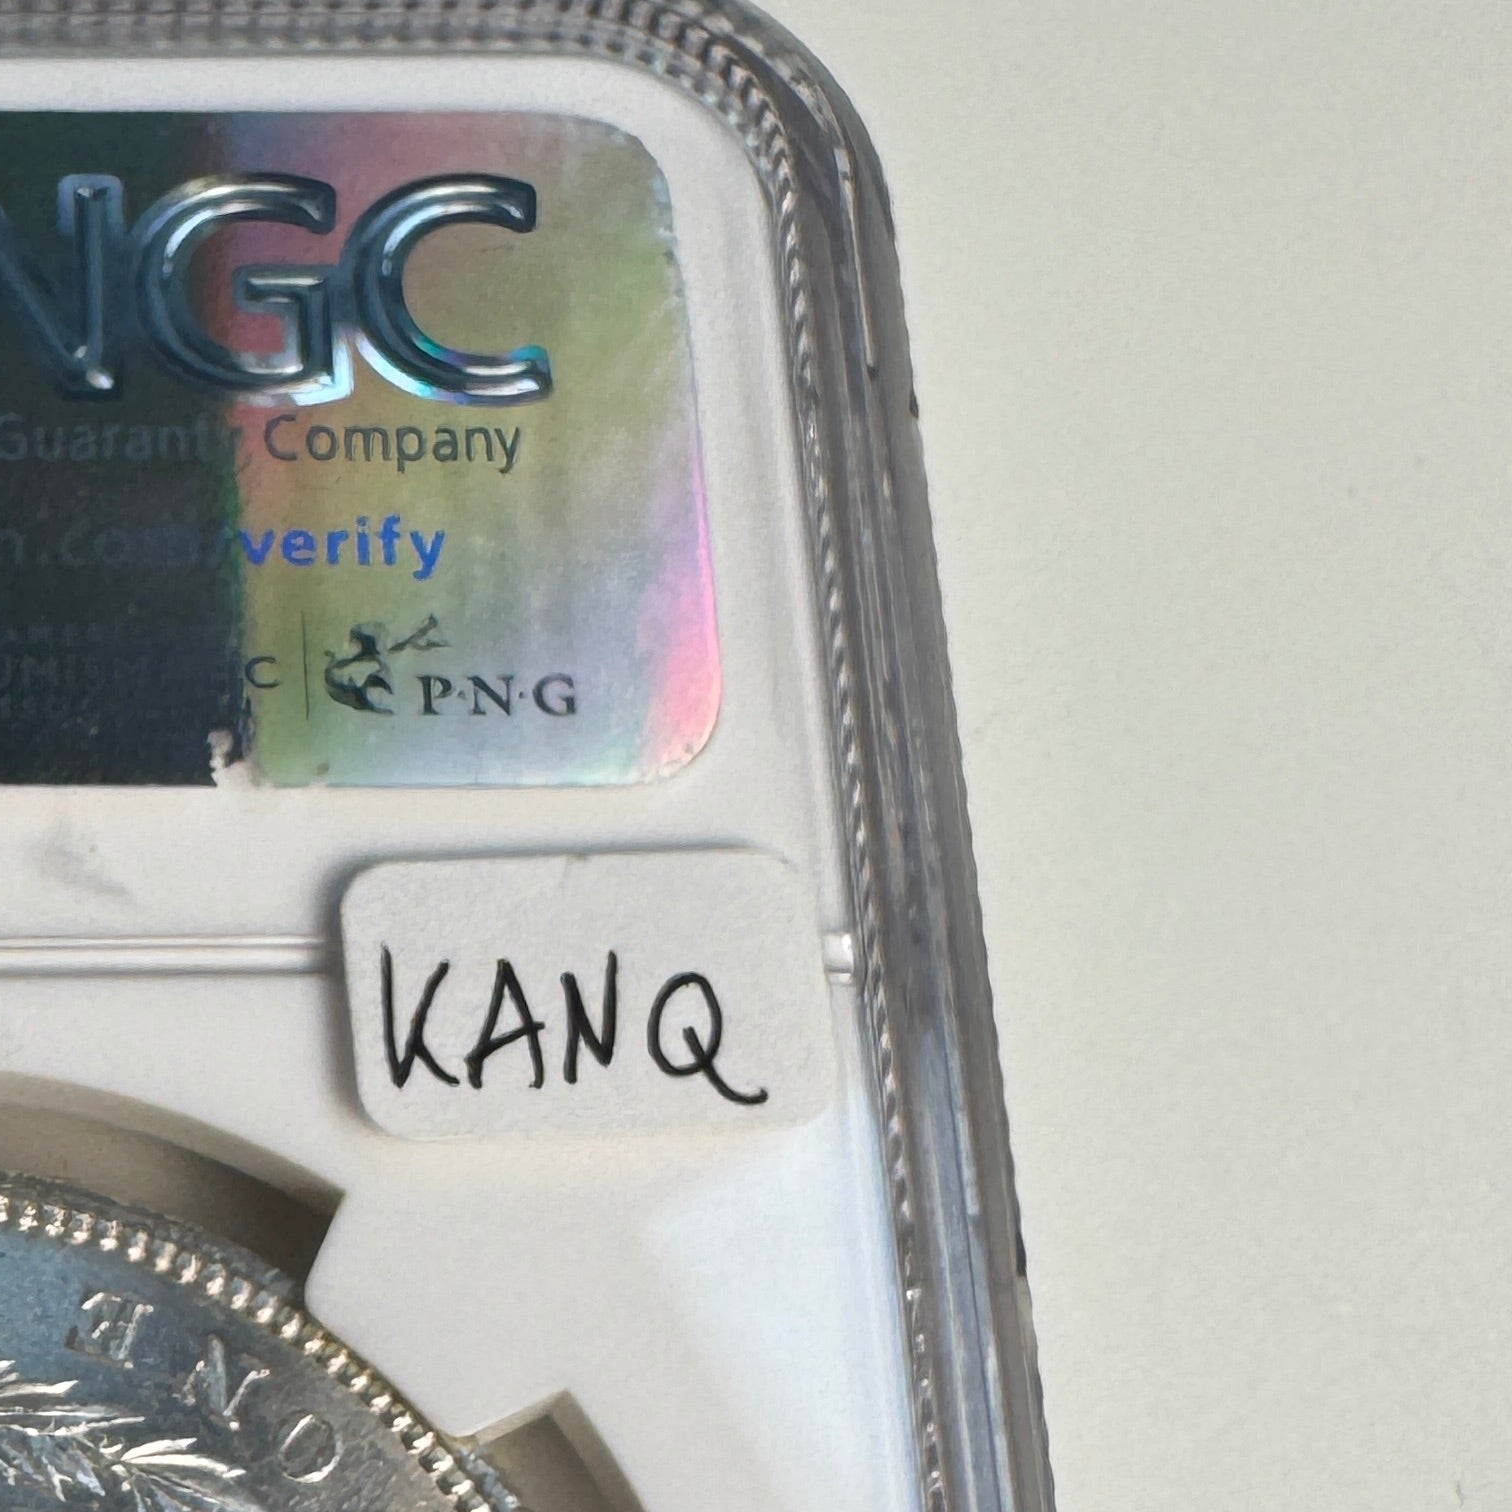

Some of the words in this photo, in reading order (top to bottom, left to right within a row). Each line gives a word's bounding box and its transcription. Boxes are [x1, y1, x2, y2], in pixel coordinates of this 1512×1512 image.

[264, 413, 522, 474] Company
[378, 942, 769, 1106] KANQ
[65, 1290, 343, 1484] ONE
